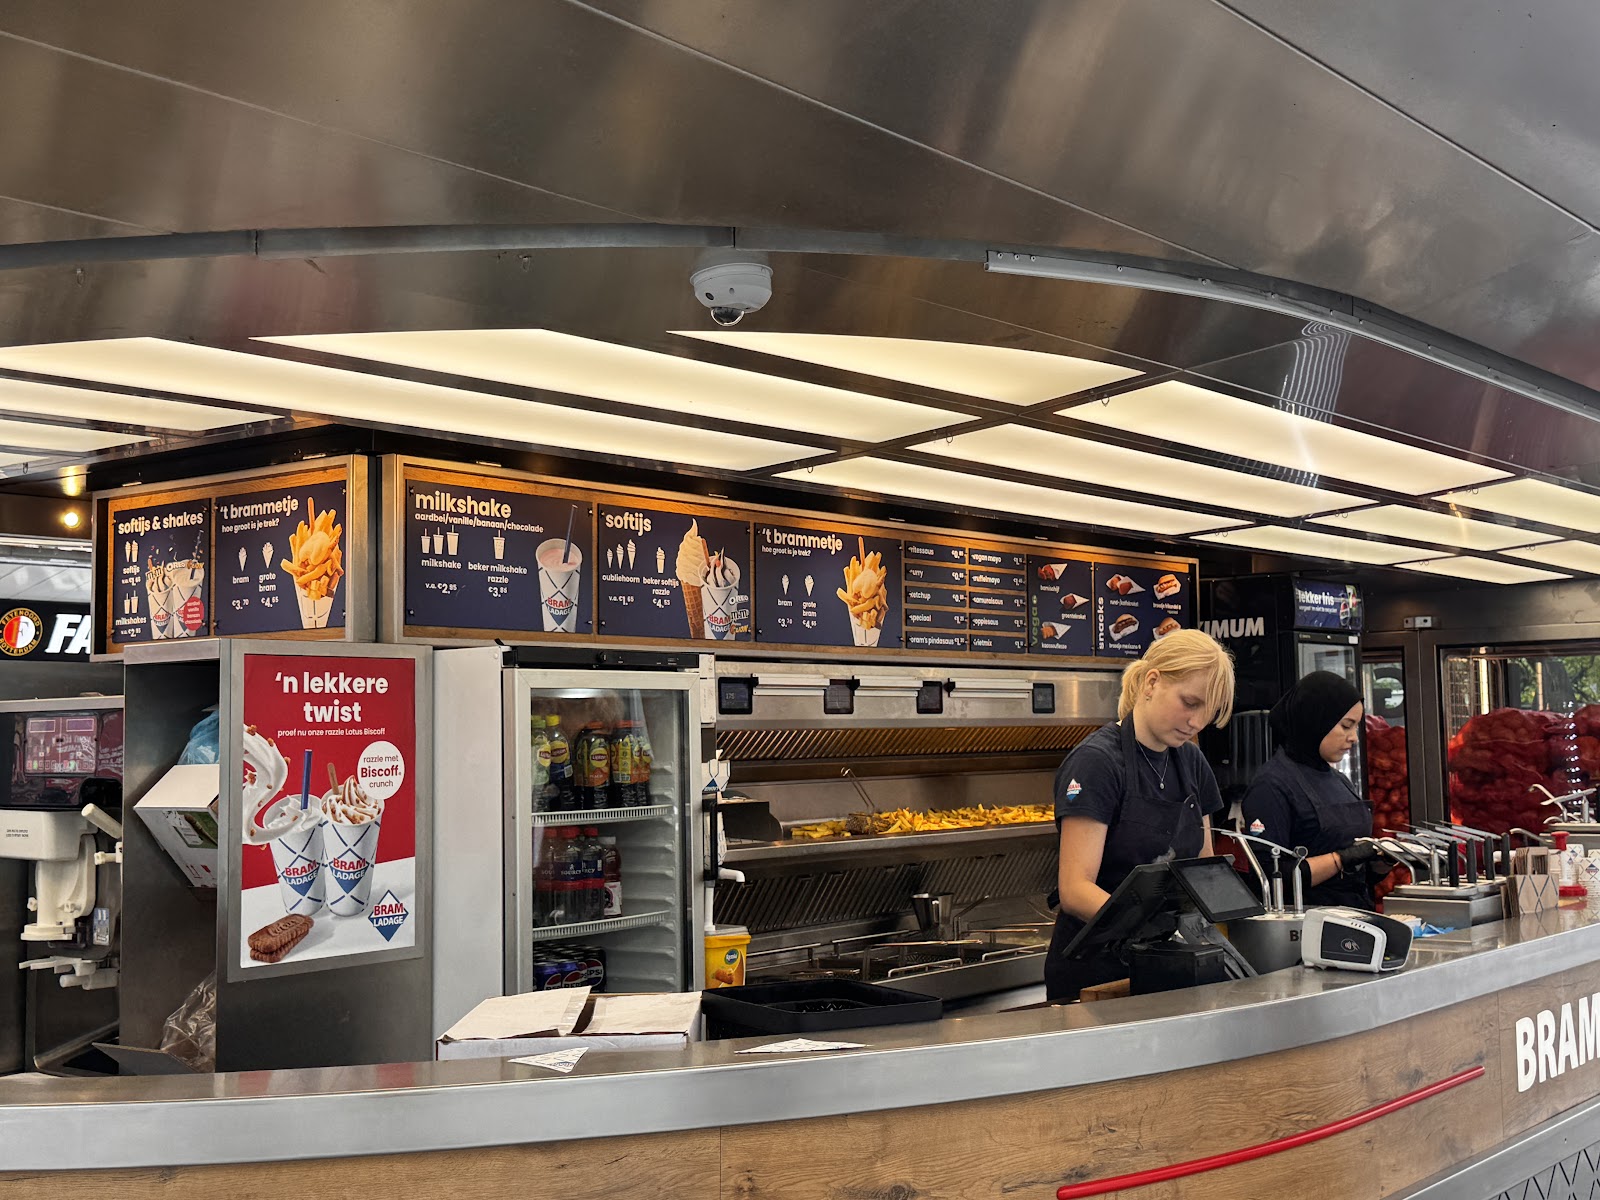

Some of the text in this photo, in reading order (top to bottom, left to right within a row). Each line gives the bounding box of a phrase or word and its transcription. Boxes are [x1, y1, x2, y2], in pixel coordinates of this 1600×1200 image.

[220, 495, 299, 519] 't brammetje
[415, 490, 512, 519] milkshake
[118, 511, 204, 537] softijs & shakes
[221, 518, 280, 533] hoe groot is je trek?
[414, 512, 544, 533] aardbei/vanille/banaan/chocolade
[605, 511, 652, 537] softijs
[773, 528, 843, 555] brammetje
[762, 545, 773, 553] hoe
[773, 547, 787, 556] groot
[792, 548, 798, 557] je
[908, 546, 935, 556] ritessaus
[421, 558, 528, 575] milkshake beker milkshake
[232, 572, 277, 584] bram grote
[487, 574, 509, 584] razzle
[602, 573, 680, 588] oubliehoorn beker softijs
[909, 569, 924, 579] urry
[258, 583, 277, 592] bram
[652, 588, 671, 596] razzle
[232, 598, 249, 610] €3.70
[547, 597, 571, 609] BRAM
[777, 599, 793, 607] bram
[802, 601, 817, 609] grote
[972, 617, 999, 627] oppiesaus
[1031, 606, 1040, 646] vega
[1097, 596, 1105, 650] snacks
[275, 671, 389, 694] 'n lekkere
[303, 698, 362, 723] twist
[277, 728, 297, 738] proef
[297, 729, 307, 737] nu
[325, 728, 344, 736] razzle
[345, 728, 363, 736] Lotus
[364, 727, 386, 736] Biscoff
[363, 754, 399, 763] razzle met
[360, 764, 400, 778] Biscoff
[369, 779, 394, 788] crunch
[285, 859, 317, 877] BRAM
[333, 857, 366, 871] BRAM
[285, 871, 318, 885] LADAGE
[332, 869, 366, 881] LADAGE
[373, 902, 404, 916] BRAM
[373, 916, 404, 928] LADAGE
[1290, 929, 1302, 942] B
[1515, 991, 1600, 1093] BRAM
